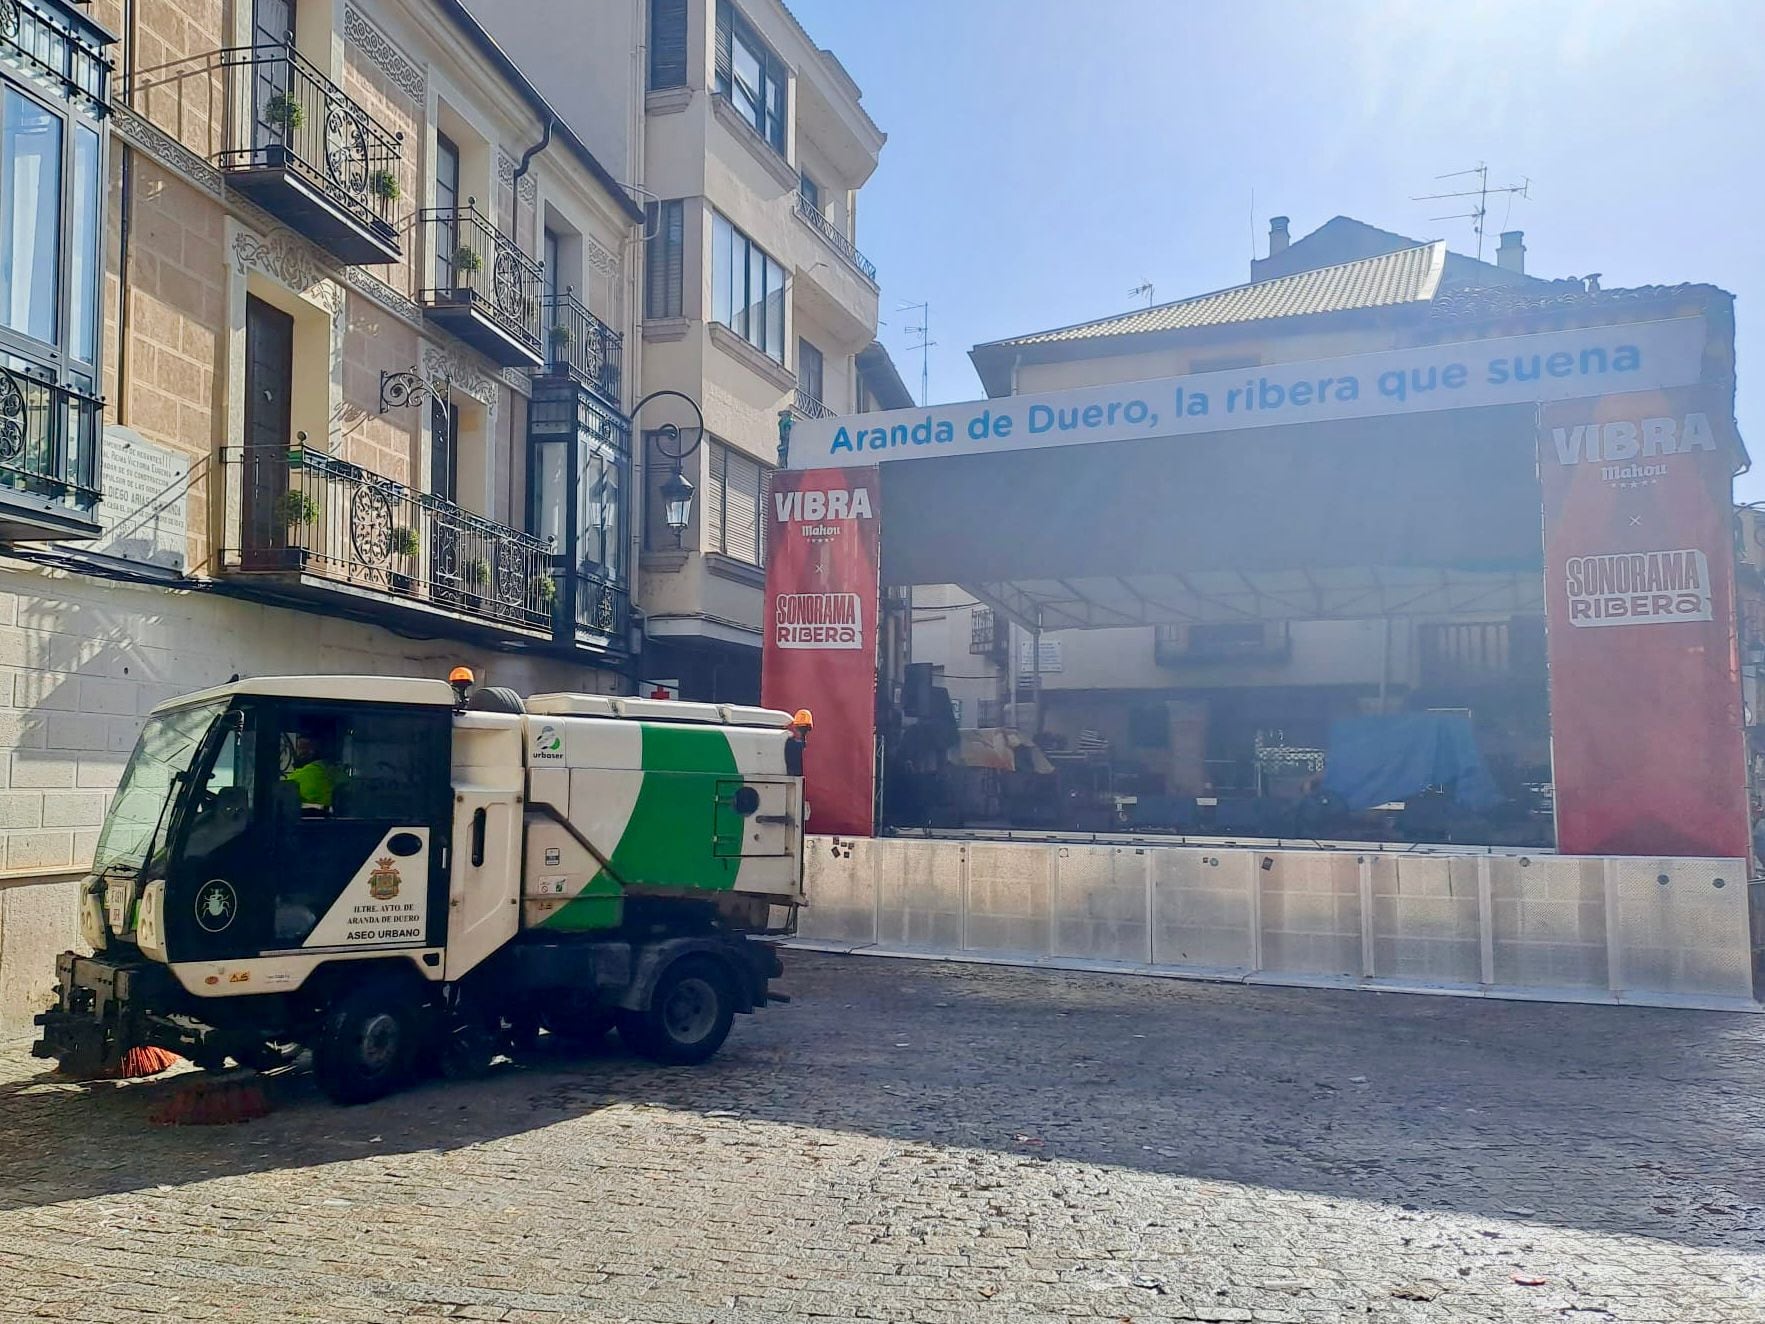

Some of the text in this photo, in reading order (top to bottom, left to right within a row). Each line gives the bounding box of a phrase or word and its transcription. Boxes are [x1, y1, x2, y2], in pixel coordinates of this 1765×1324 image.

[830, 344, 1641, 454] Aranda de Duero, la ribera que suena
[1552, 412, 1717, 465] VIBRA
[1601, 464, 1668, 481] Mahou
[774, 488, 873, 522] VIBRA
[802, 524, 841, 537] Mahou
[1567, 551, 1701, 597] SONORAMA
[777, 595, 855, 624] SONORAMA
[533, 751, 564, 759] urbaser
[347, 914, 420, 925] ARANDA DE DUERO
[346, 928, 420, 940] ASEO URBANO
